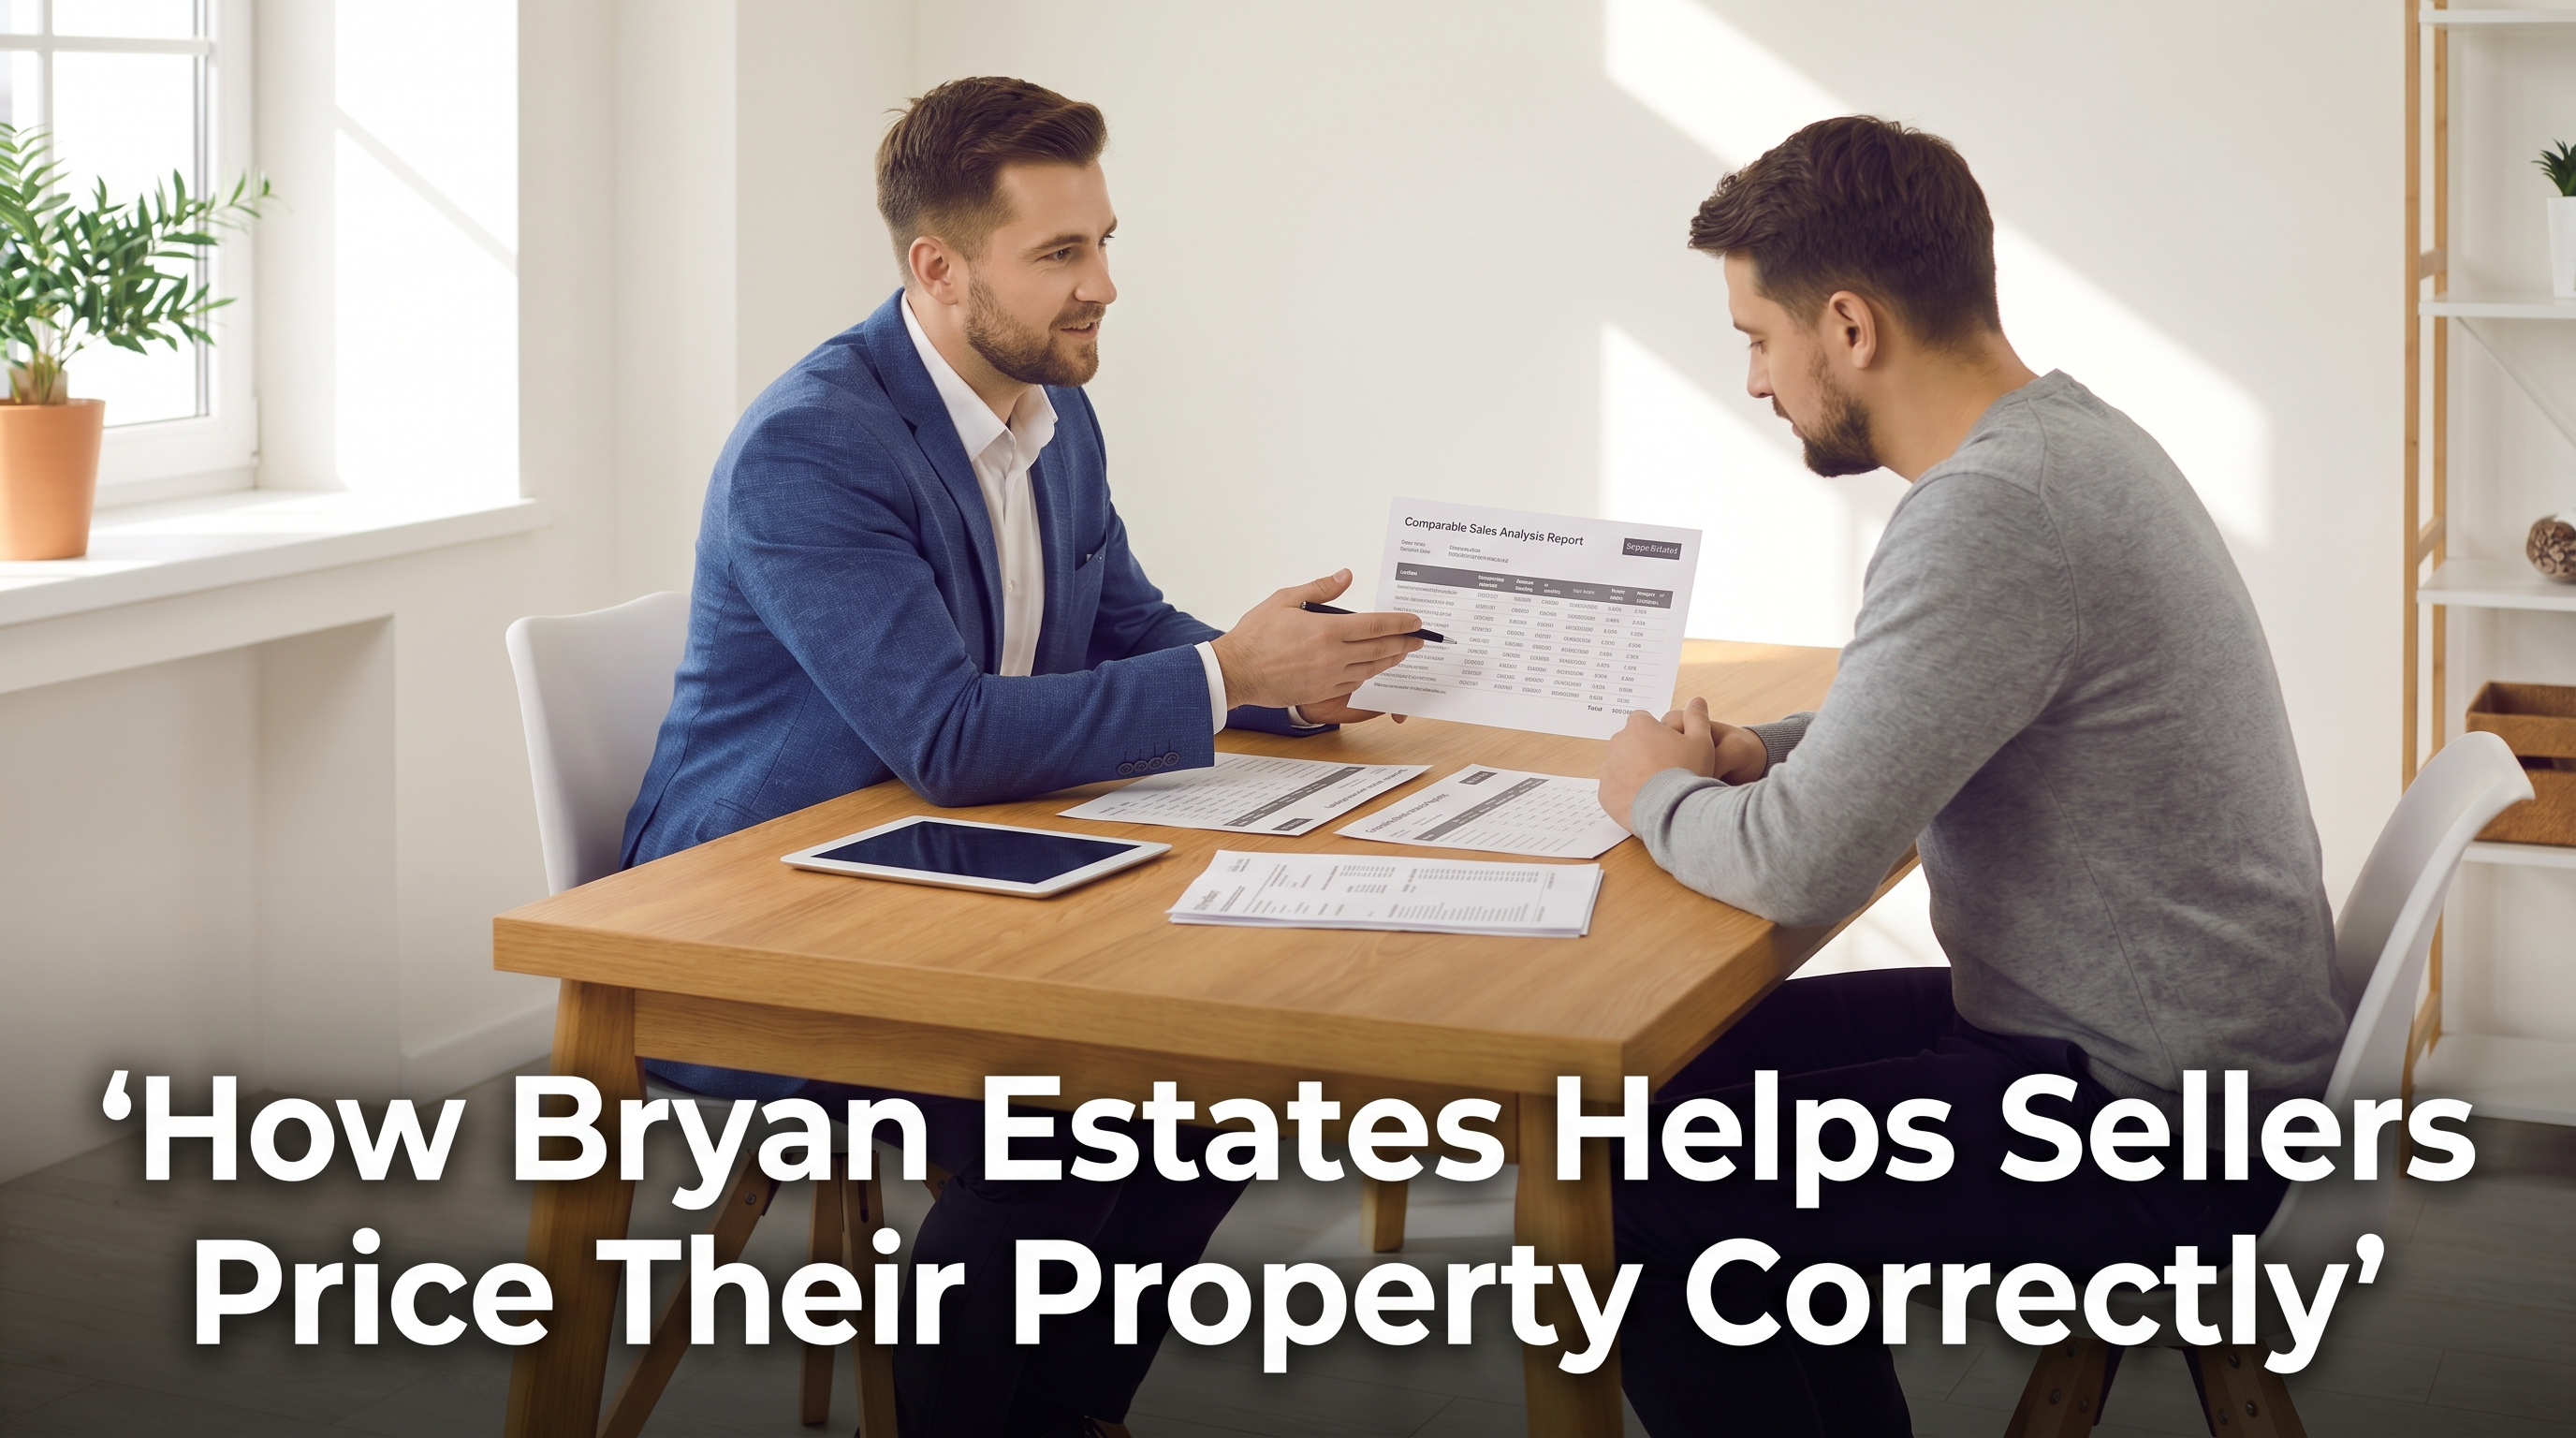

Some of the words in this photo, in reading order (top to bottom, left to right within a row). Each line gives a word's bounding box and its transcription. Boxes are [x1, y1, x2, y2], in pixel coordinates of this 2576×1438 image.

[1404, 516, 1467, 534] Comparable
[1469, 523, 1498, 536] Sales
[1500, 527, 1544, 542] Analysis
[1546, 532, 1584, 546] Report
